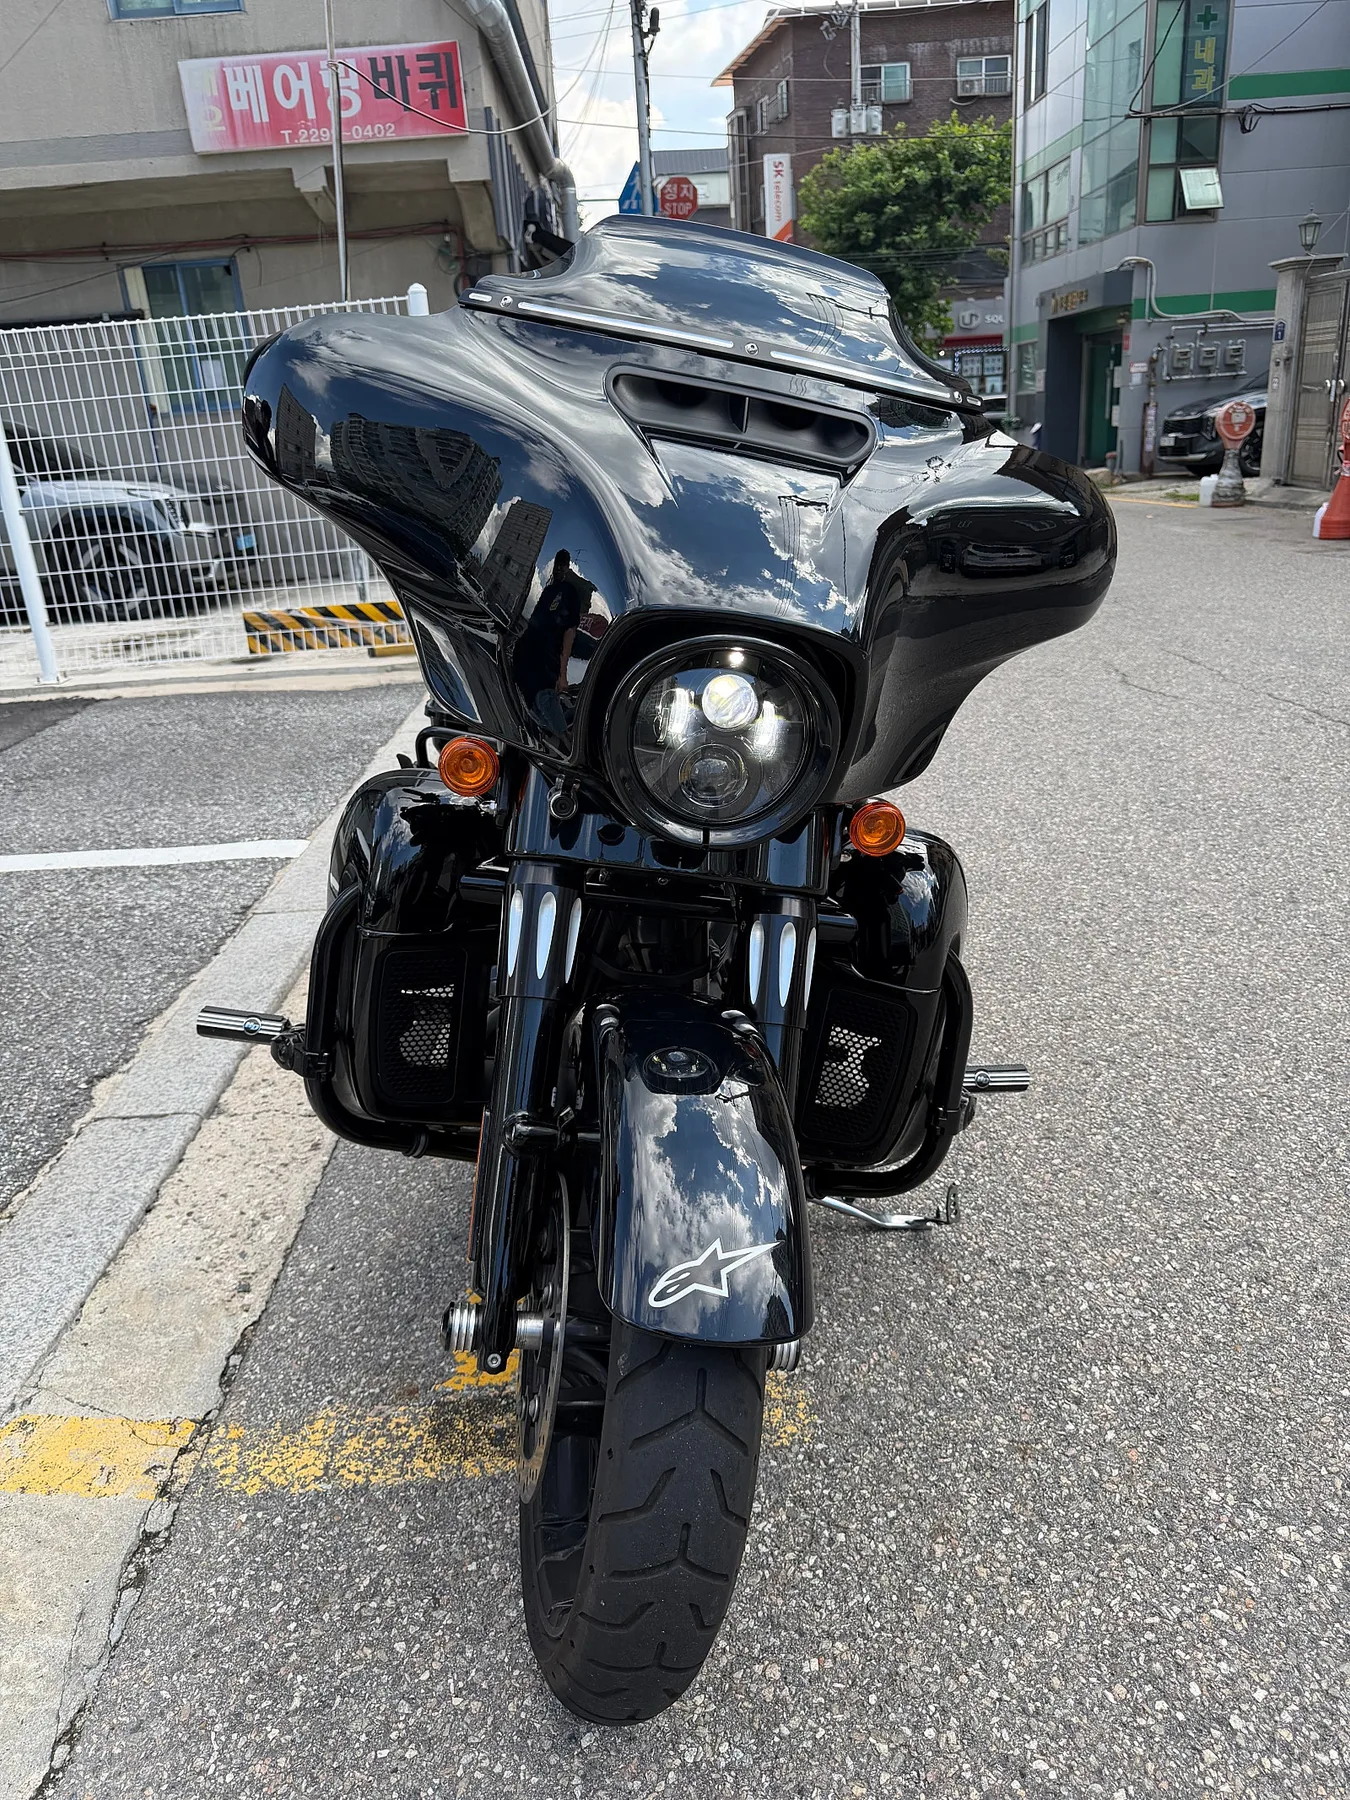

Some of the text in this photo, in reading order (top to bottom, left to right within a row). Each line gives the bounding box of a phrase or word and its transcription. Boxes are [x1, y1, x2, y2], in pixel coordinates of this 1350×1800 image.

[367, 52, 458, 112] 바퀴
[1191, 36, 1216, 93] 내과
[663, 202, 692, 215] STOP
[664, 184, 694, 200] 정지
[773, 160, 785, 222] SK telecom
